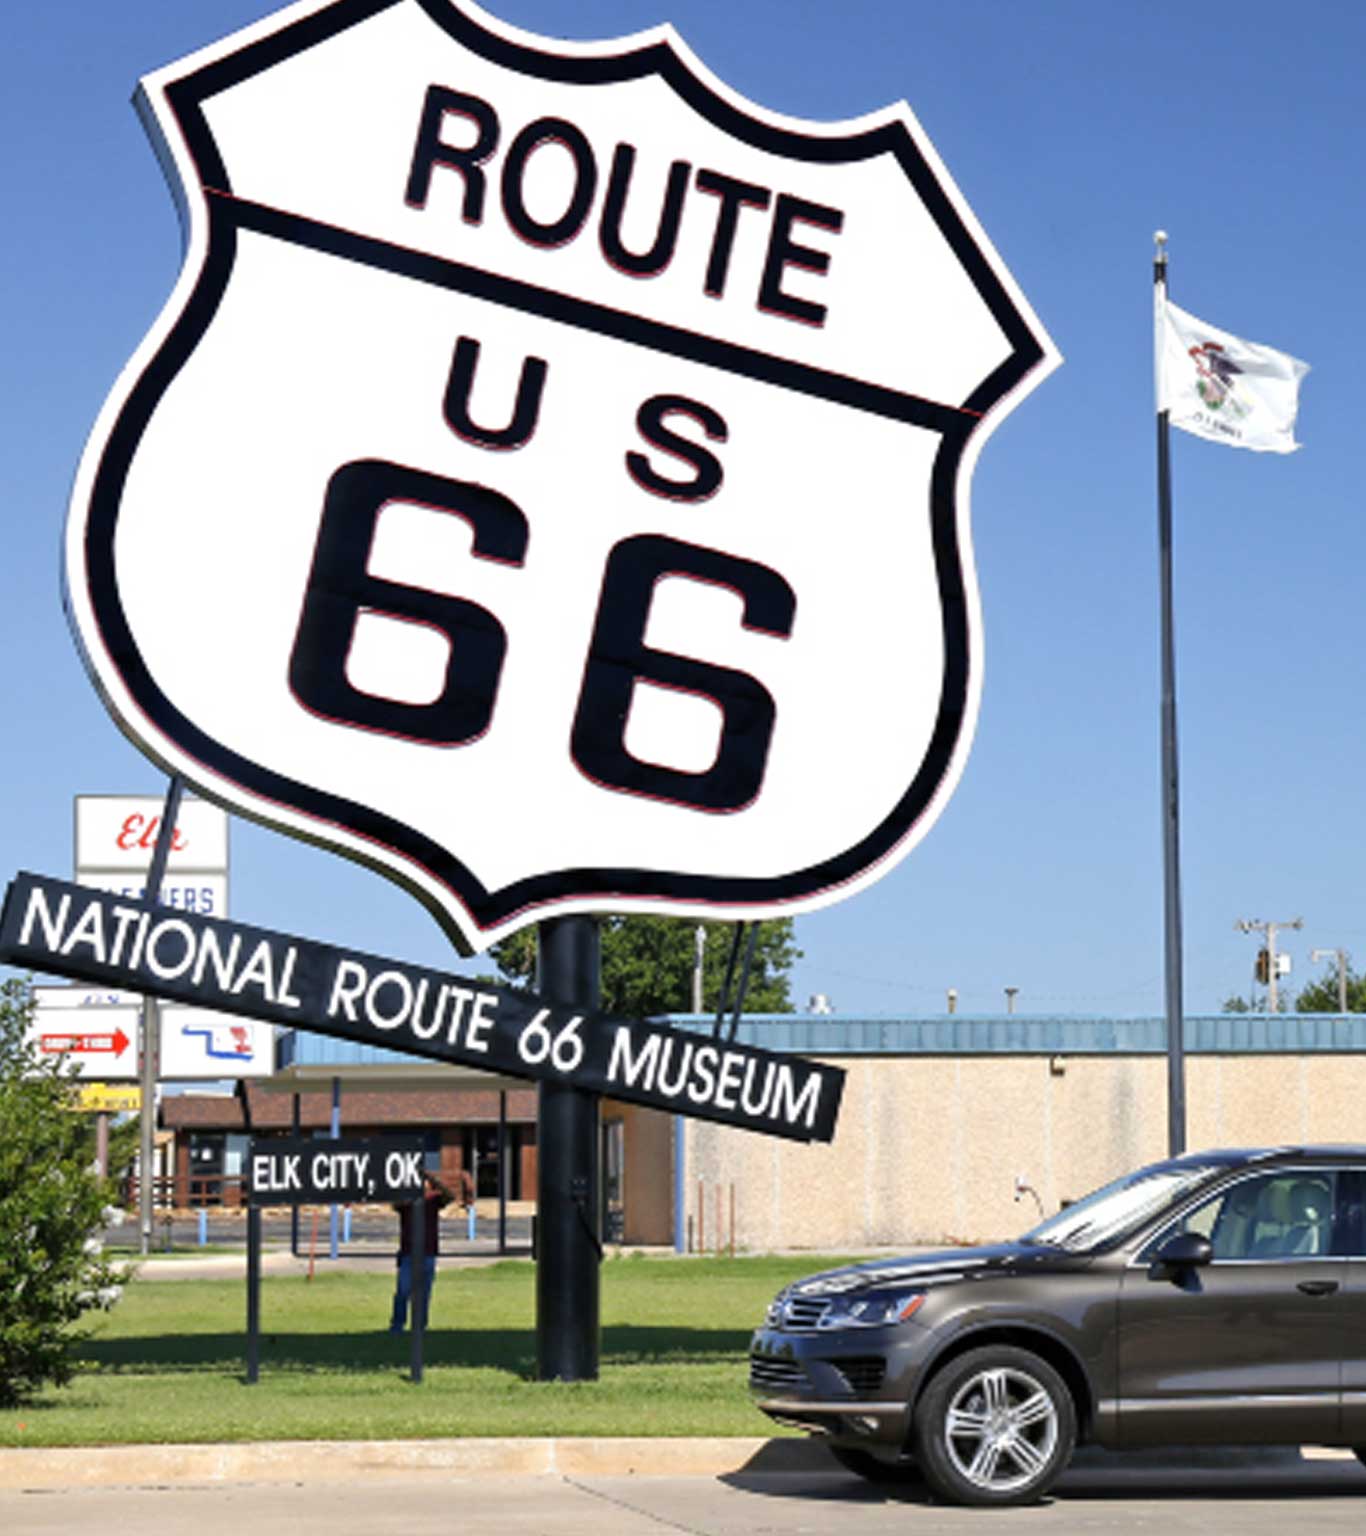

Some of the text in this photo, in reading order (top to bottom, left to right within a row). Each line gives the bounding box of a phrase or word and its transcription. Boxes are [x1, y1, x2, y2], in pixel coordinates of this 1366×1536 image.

[404, 83, 845, 329] ROUTE
[18, 887, 822, 1128] NATIONAL ROUTE 66 MUSEUM
[252, 1151, 423, 1195] ELK CITY, OK
